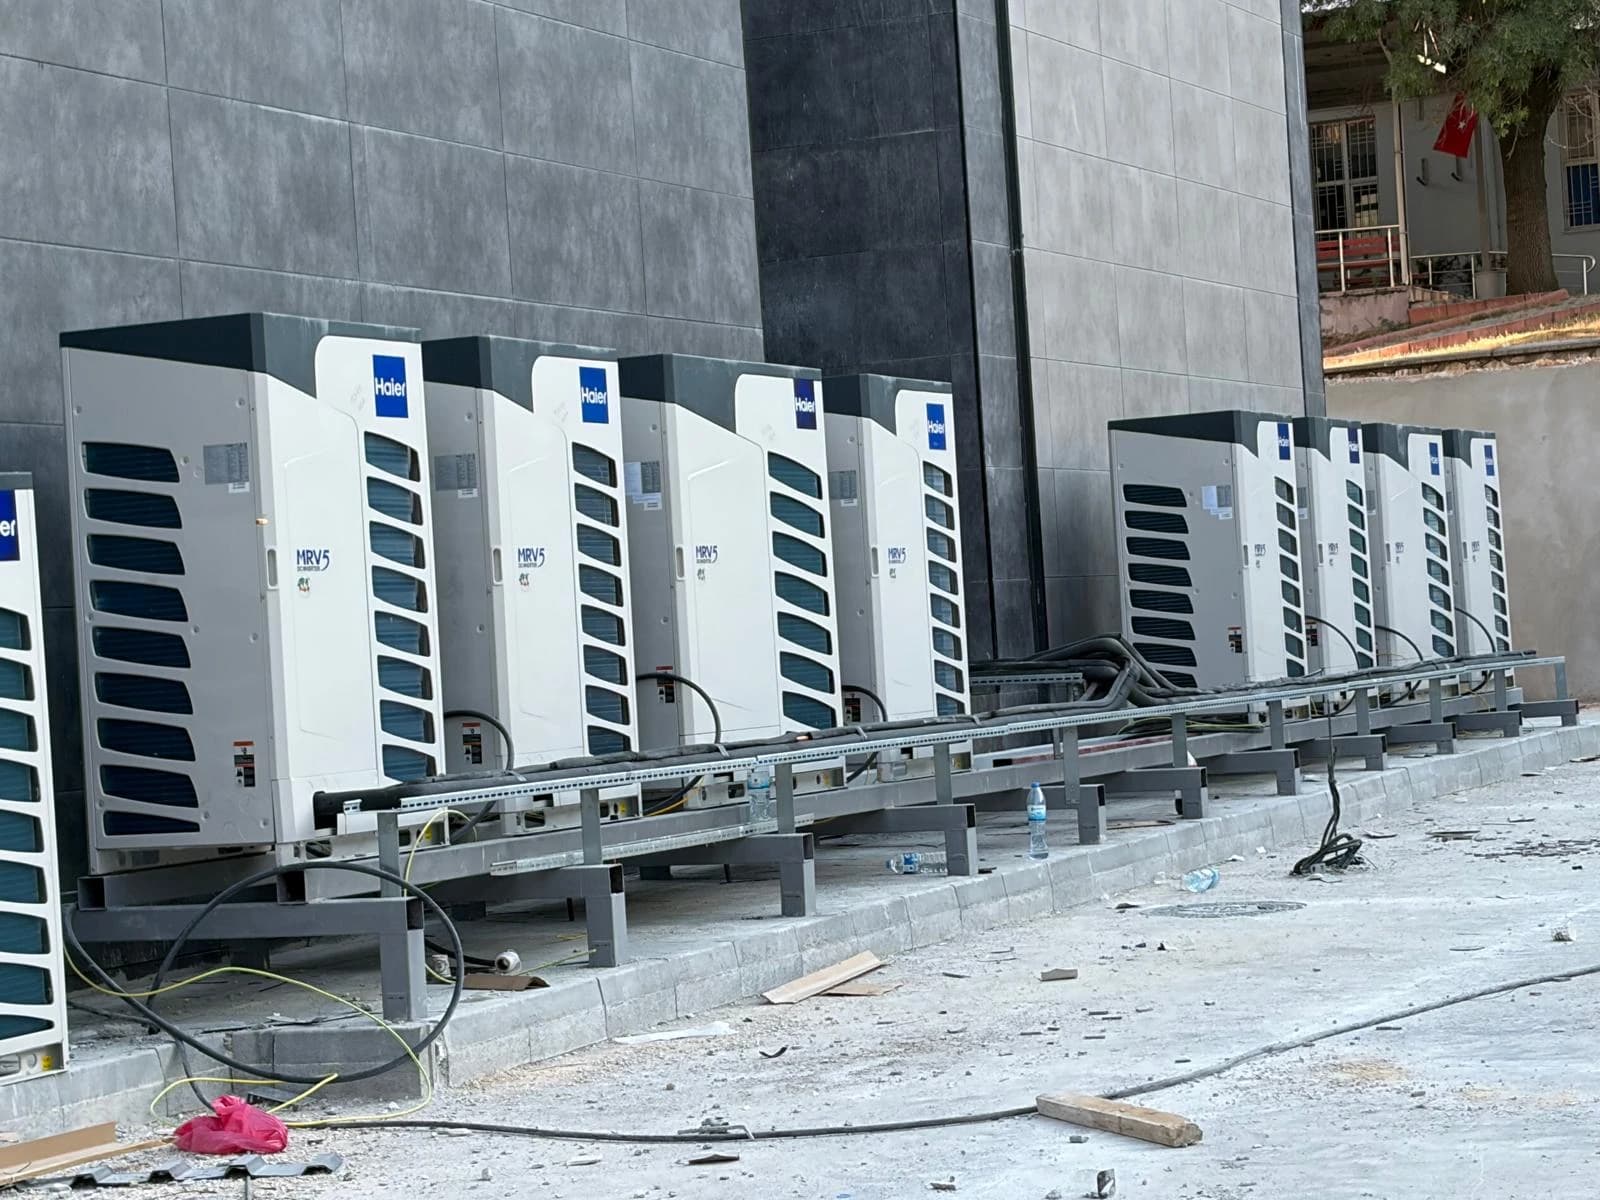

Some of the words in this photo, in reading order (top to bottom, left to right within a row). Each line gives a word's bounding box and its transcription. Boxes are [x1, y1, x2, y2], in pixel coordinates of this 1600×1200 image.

[374, 378, 406, 397] Haier
[581, 386, 607, 405] Haier
[794, 397, 816, 413] Haier
[927, 420, 945, 434] Haier
[0, 519, 16, 536] er
[296, 549, 330, 571] MRV5
[518, 547, 546, 568] MRV5
[696, 545, 718, 564] MRV5
